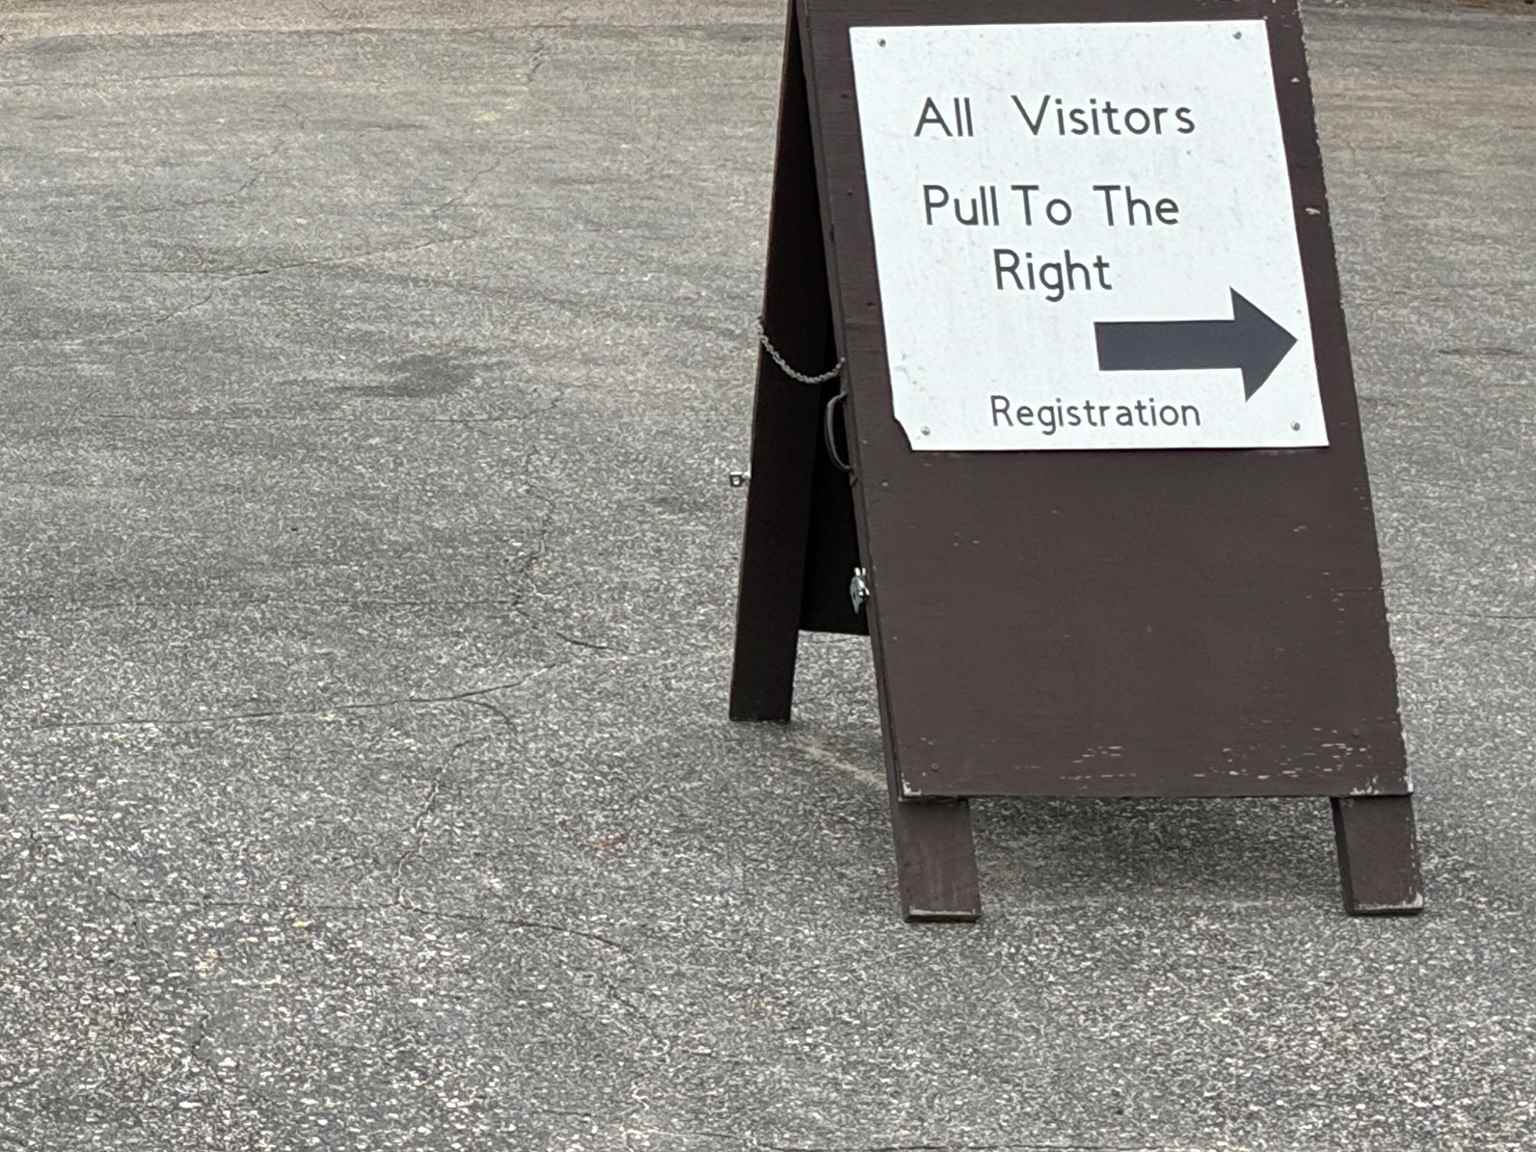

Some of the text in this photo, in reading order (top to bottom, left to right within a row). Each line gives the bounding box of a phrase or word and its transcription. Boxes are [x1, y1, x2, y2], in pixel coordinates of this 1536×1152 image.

[914, 94, 1196, 138] All Visitors
[922, 184, 1181, 226] Pull To The
[993, 249, 1113, 301] Right
[990, 394, 1202, 436] Registration
